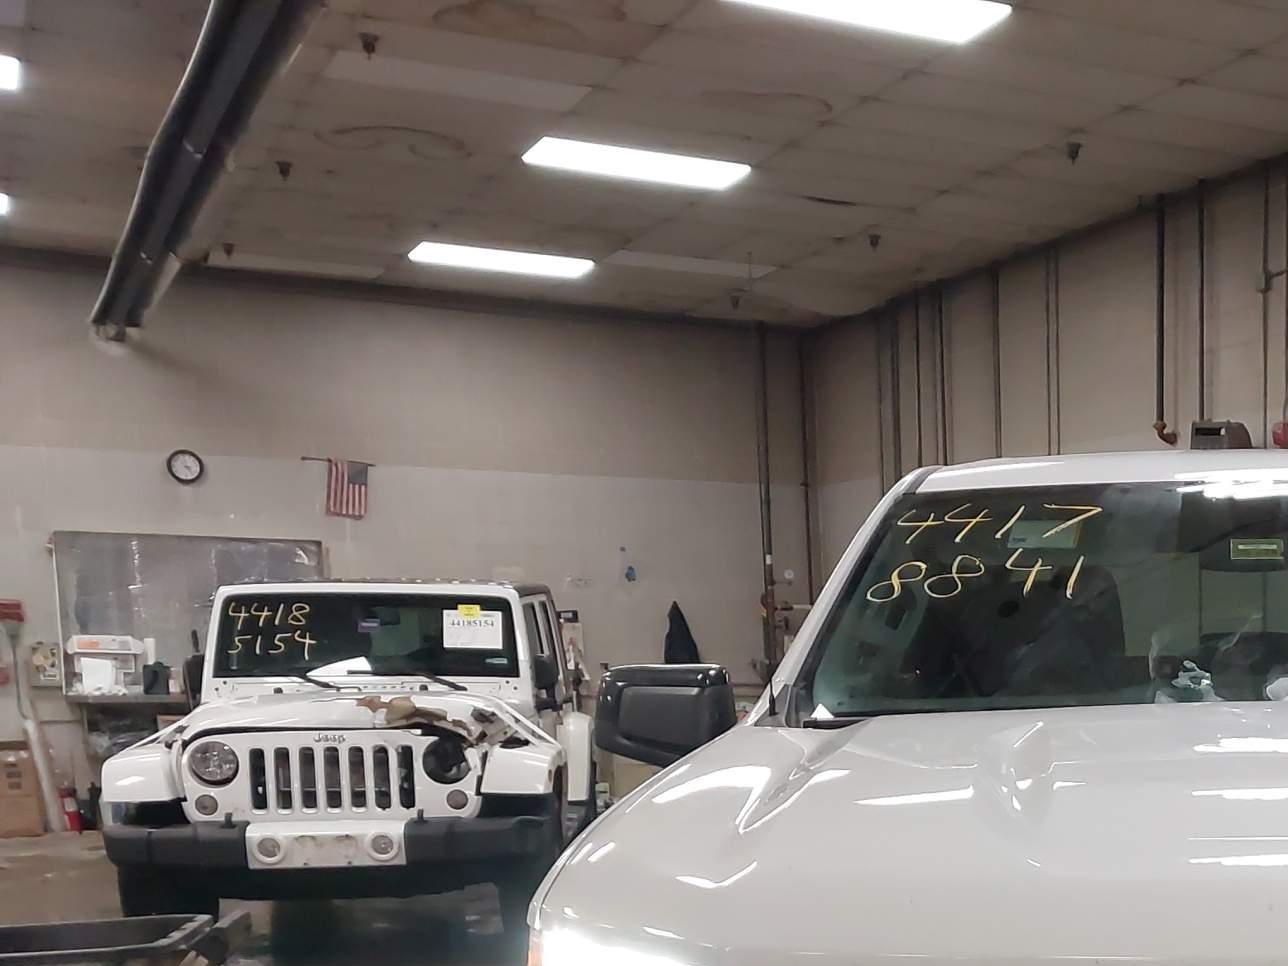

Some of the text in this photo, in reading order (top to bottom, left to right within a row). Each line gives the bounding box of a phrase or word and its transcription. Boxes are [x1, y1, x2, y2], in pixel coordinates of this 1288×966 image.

[897, 503, 1103, 544] 4417
[866, 548, 1087, 602] 8841
[228, 602, 310, 630] 4418
[227, 630, 317, 660] 5154
[313, 732, 346, 744] Jeep
